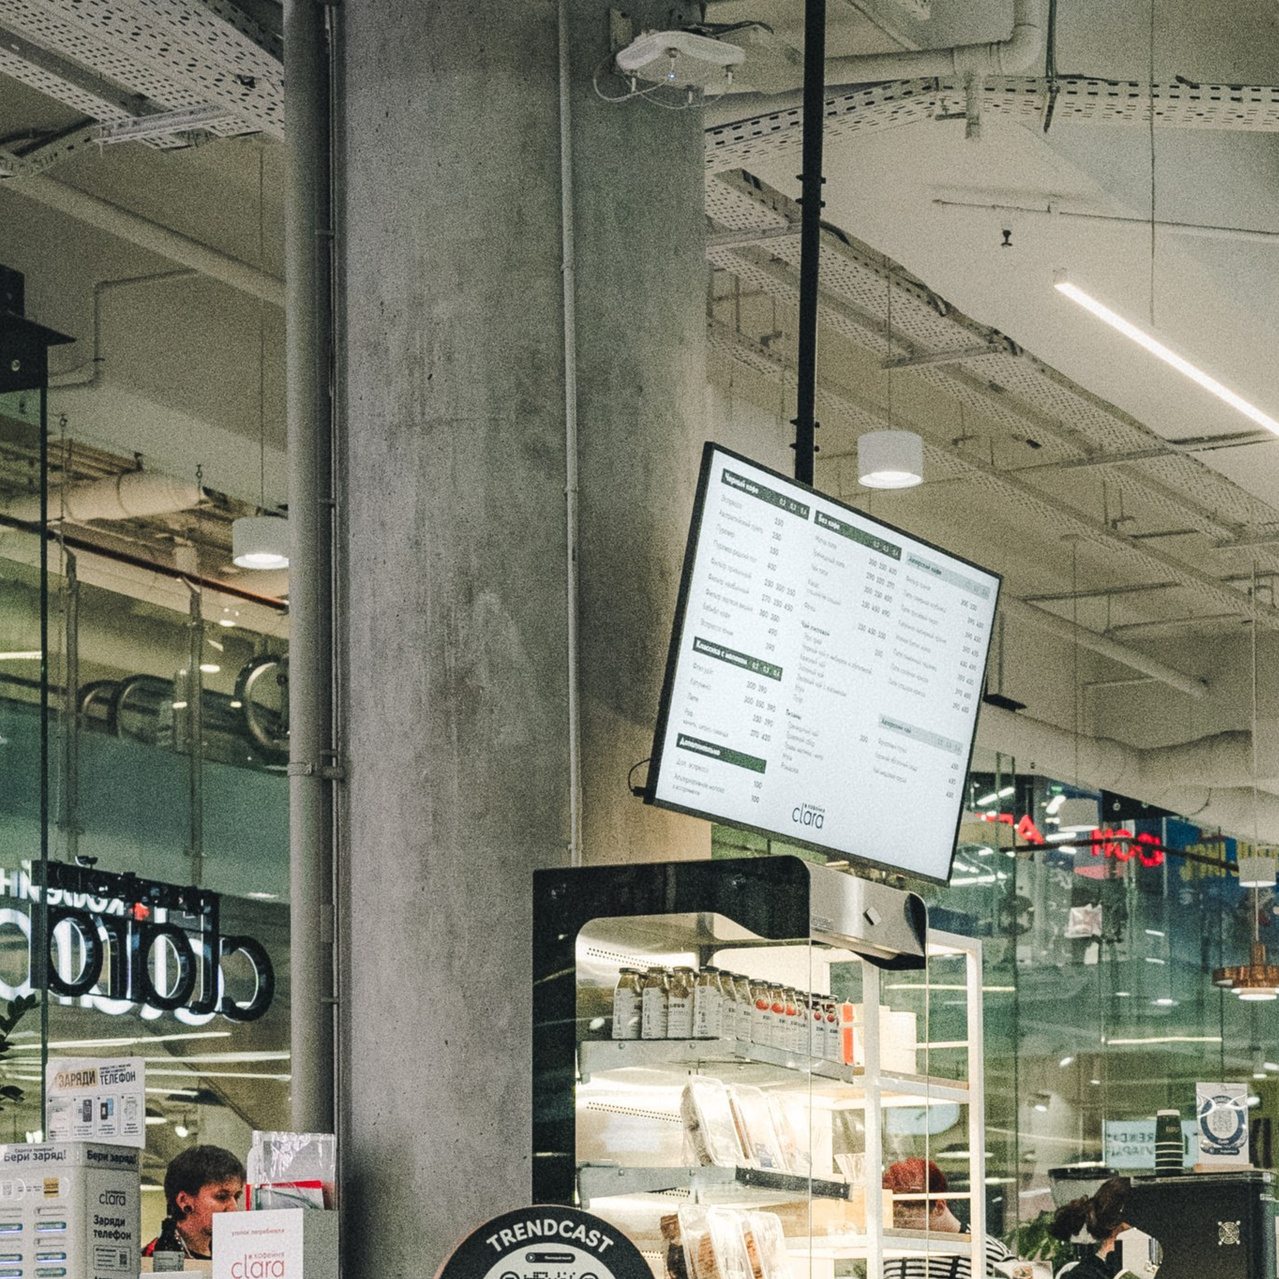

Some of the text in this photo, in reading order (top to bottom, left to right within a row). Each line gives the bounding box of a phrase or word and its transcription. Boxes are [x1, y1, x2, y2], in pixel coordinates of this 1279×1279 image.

[790, 799, 826, 830] clara
[58, 1070, 136, 1087] ЗАРЯДИ ТЕЛЕФОН
[4, 1150, 66, 1163] Бери заряд!
[87, 1150, 108, 1163] Бери
[99, 1190, 126, 1206] clara
[93, 1214, 126, 1228] Заряди
[93, 1229, 131, 1241] телефон
[231, 1228, 285, 1237] уголок потребителя
[486, 1219, 614, 1254] TRENDCAST
[231, 1254, 285, 1279] clara
